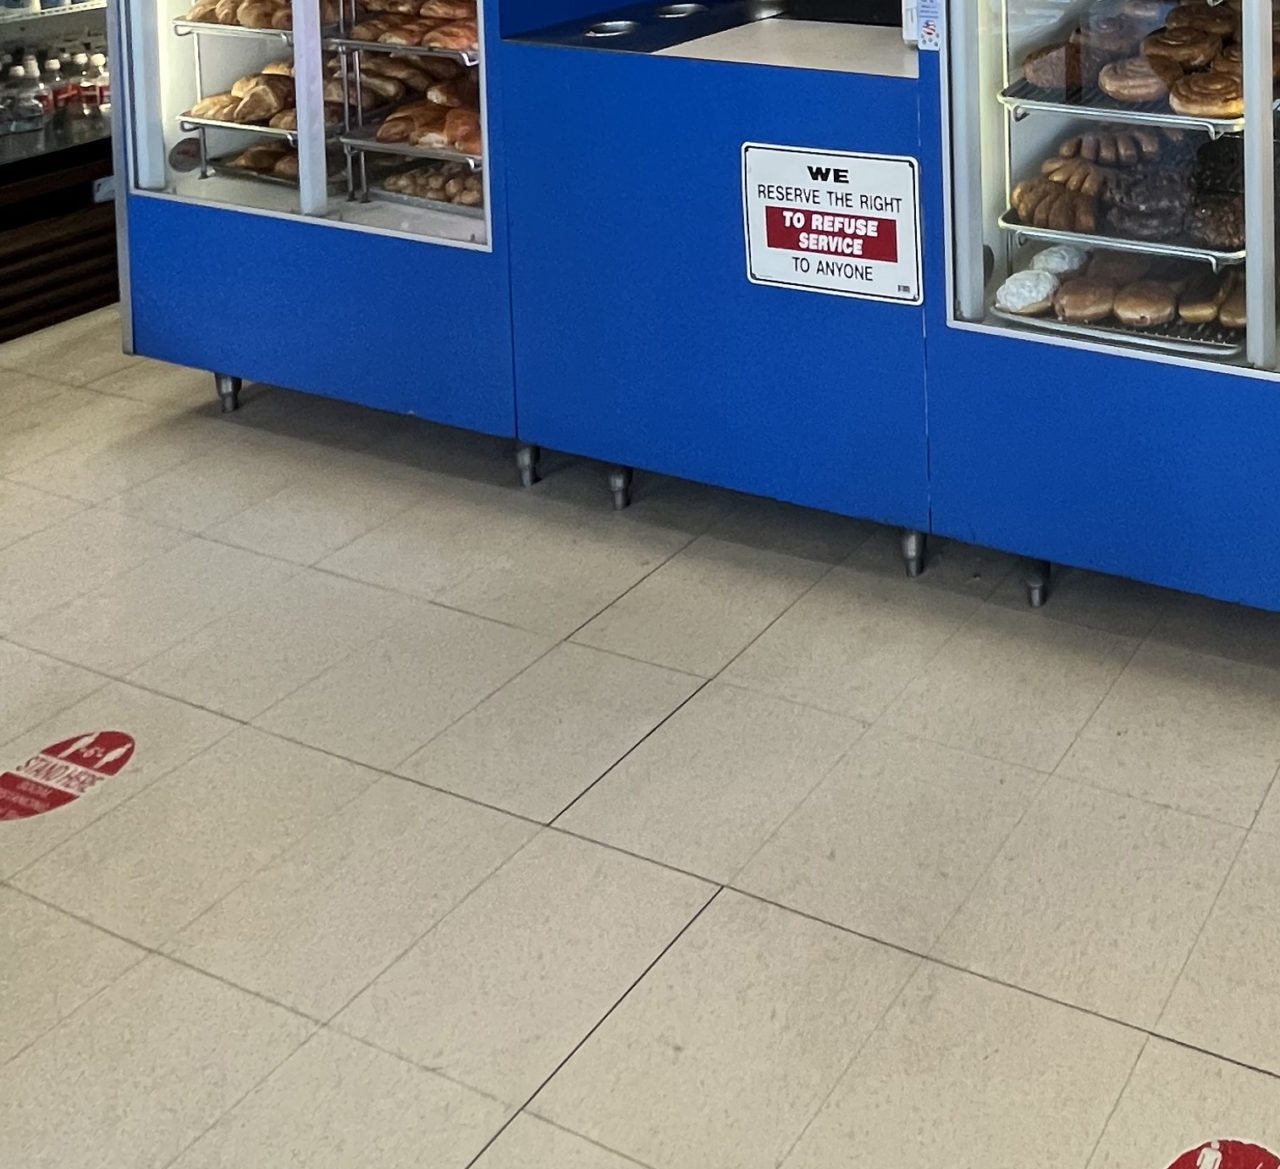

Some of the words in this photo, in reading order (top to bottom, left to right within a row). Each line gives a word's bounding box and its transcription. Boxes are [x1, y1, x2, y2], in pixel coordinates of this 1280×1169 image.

[807, 166, 849, 183] WE
[758, 184, 820, 204] RESERVE
[827, 191, 852, 207] THE
[861, 195, 902, 213] RIGHT
[783, 211, 805, 228] TO
[812, 214, 878, 237] REFUSE
[799, 233, 863, 255] SERVICE
[792, 257, 809, 272] TO
[817, 261, 873, 280] ANYONE
